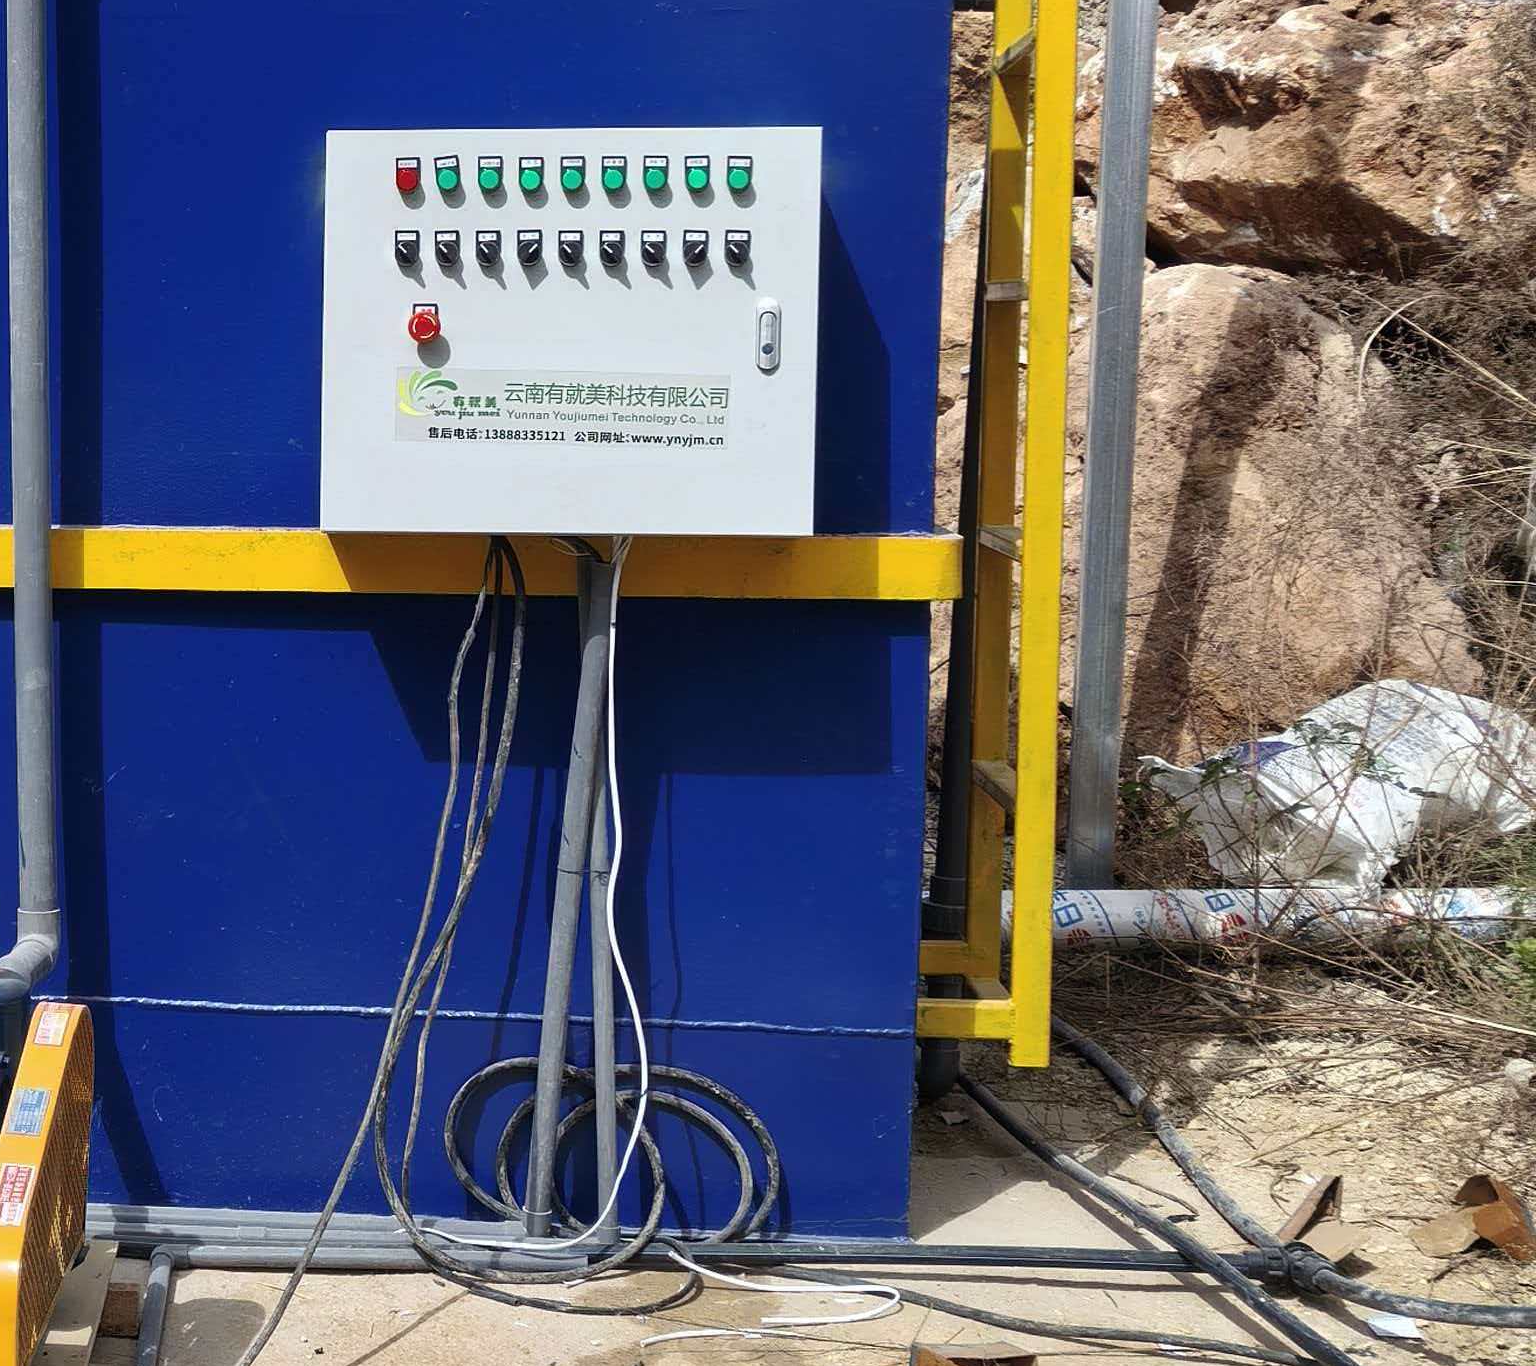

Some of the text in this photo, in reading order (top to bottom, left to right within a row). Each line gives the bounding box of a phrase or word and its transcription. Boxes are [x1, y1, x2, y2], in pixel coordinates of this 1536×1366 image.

[504, 382, 729, 409] 云南有就美科技有限公司
[507, 410, 550, 421] Yunnan
[553, 410, 609, 424] Youjiumei
[611, 412, 677, 426] Technology
